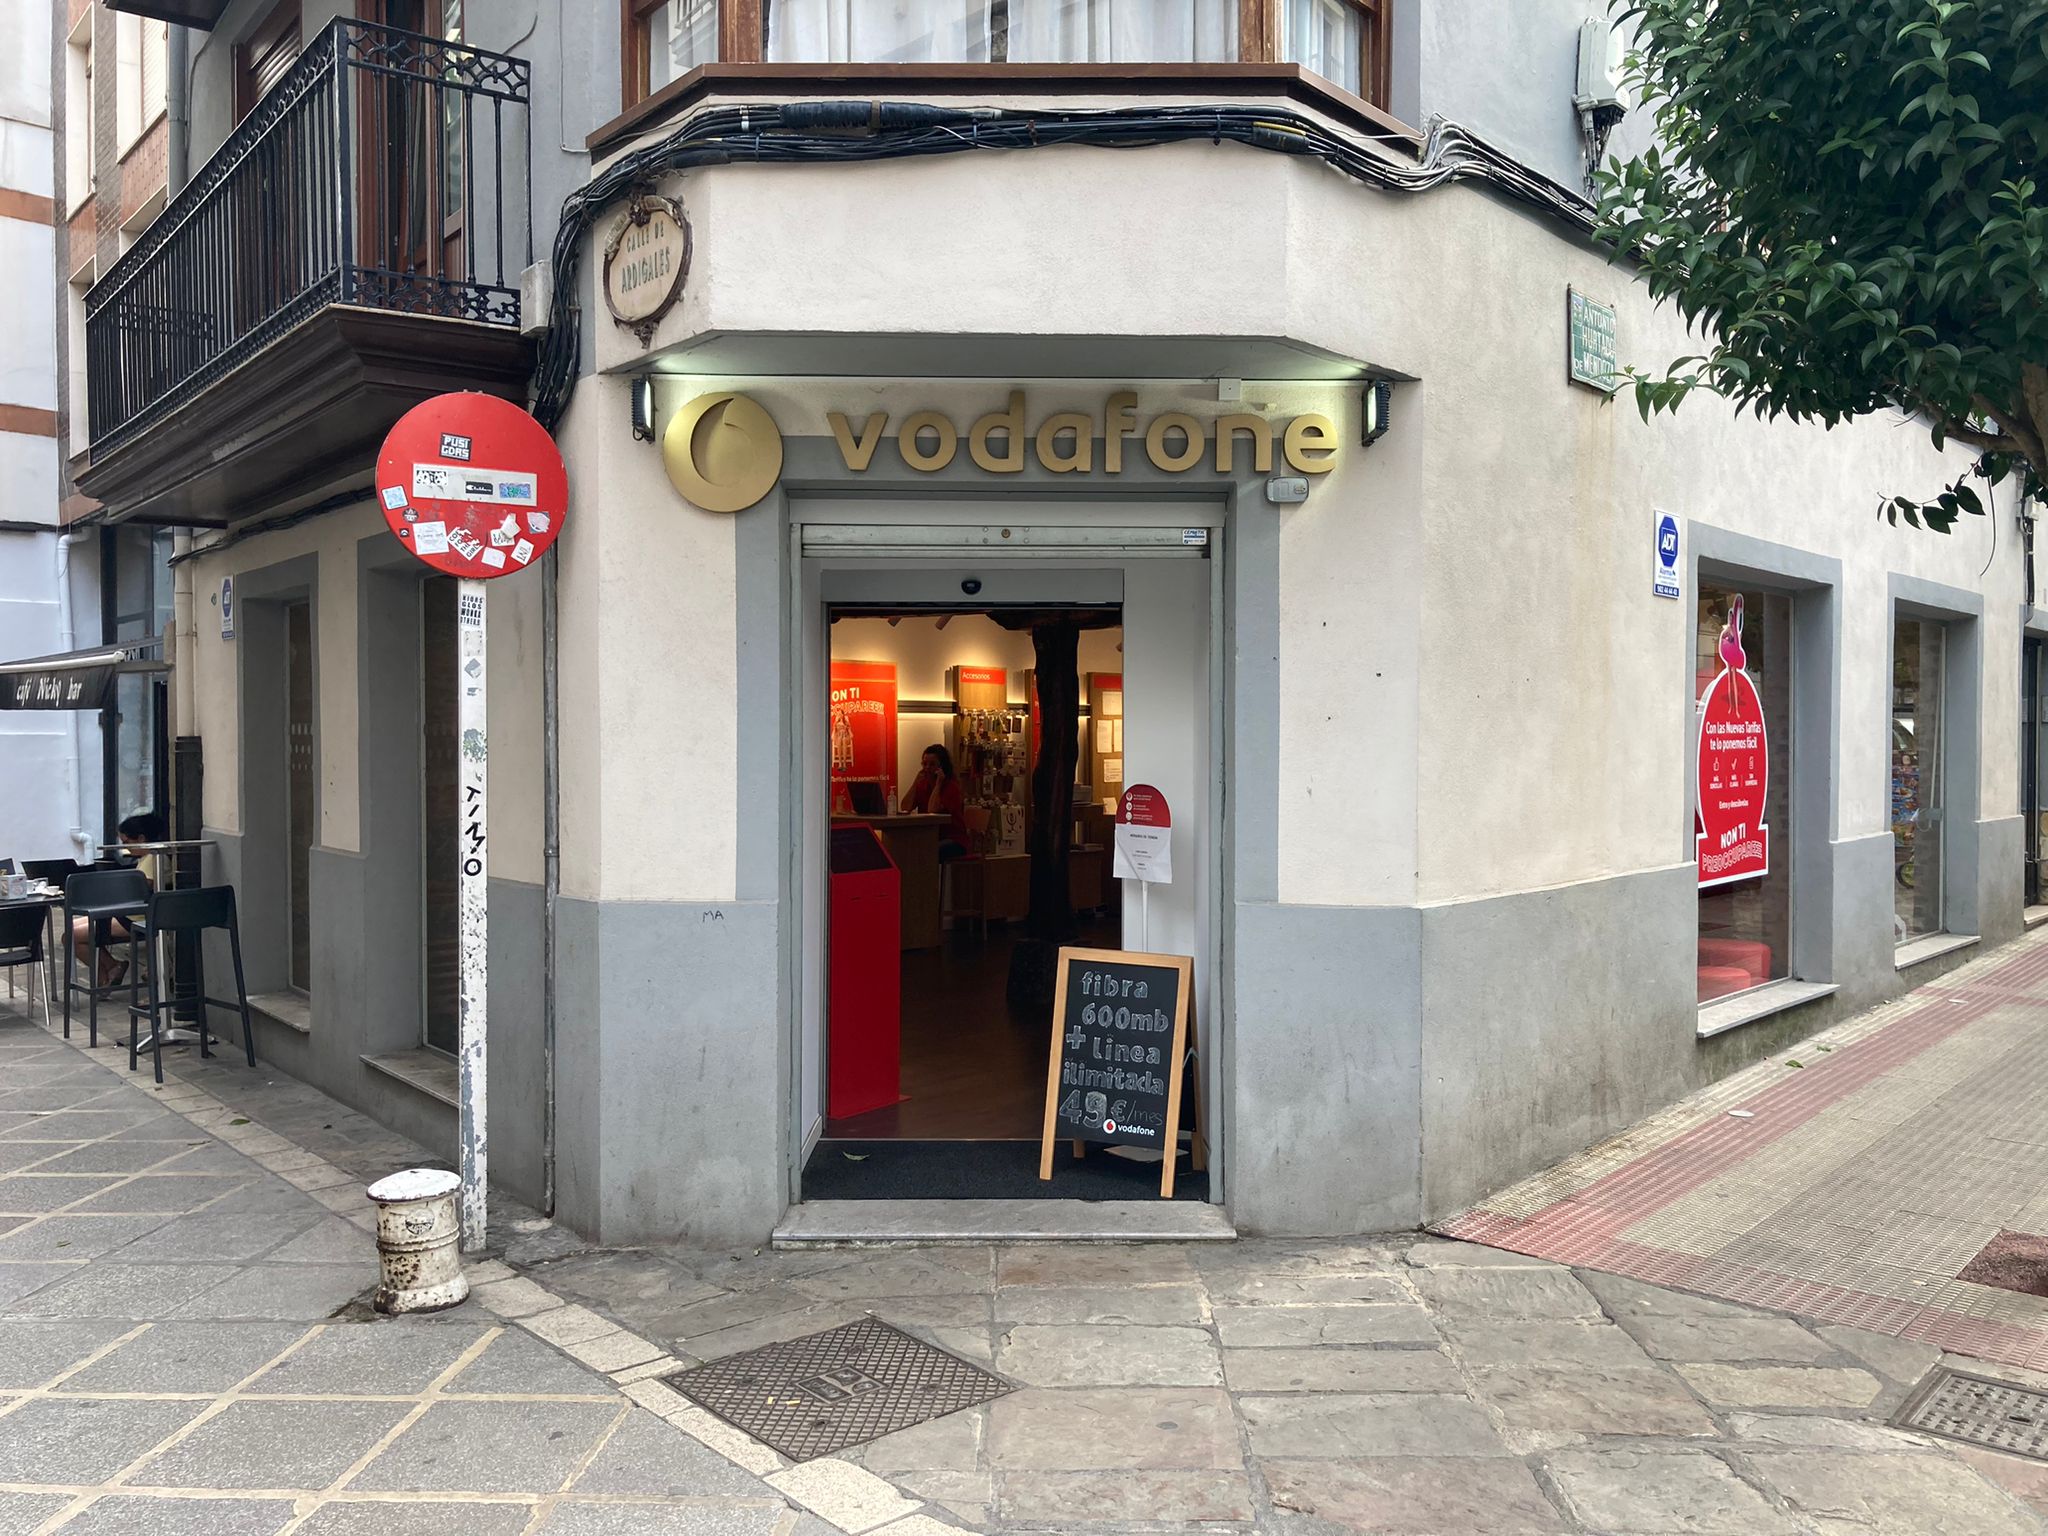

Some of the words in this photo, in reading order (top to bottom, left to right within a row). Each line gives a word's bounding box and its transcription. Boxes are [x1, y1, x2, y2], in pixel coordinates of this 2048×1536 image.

[627, 229, 650, 252] CALLE
[655, 220, 665, 238] DE
[621, 246, 671, 294] ARDIGALES
[1583, 306, 1617, 334] ANTONIO
[1574, 359, 1583, 372] DE
[827, 390, 1339, 475] vodafone
[1661, 532, 1677, 551] ADT
[962, 672, 991, 681] Accesorios
[66, 677, 82, 700] bar
[849, 687, 860, 699] TI
[1706, 721, 1717, 734] Con
[1717, 721, 1725, 734] las
[1726, 721, 1745, 734] Nuevas
[1745, 721, 1762, 734] Tarifas
[1710, 738, 1716, 750] te
[1716, 737, 1722, 750] lo
[1722, 739, 1746, 752] ponemos
[1720, 826, 1737, 849] NON
[1738, 822, 1746, 840] TI
[702, 909, 725, 923] MA
[1081, 970, 1148, 998] fibra
[1081, 1002, 1169, 1032] 600mb
[1066, 1025, 1086, 1049] +
[1063, 1060, 1164, 1095] ilimitada
[1118, 1123, 1156, 1137] vodafone
